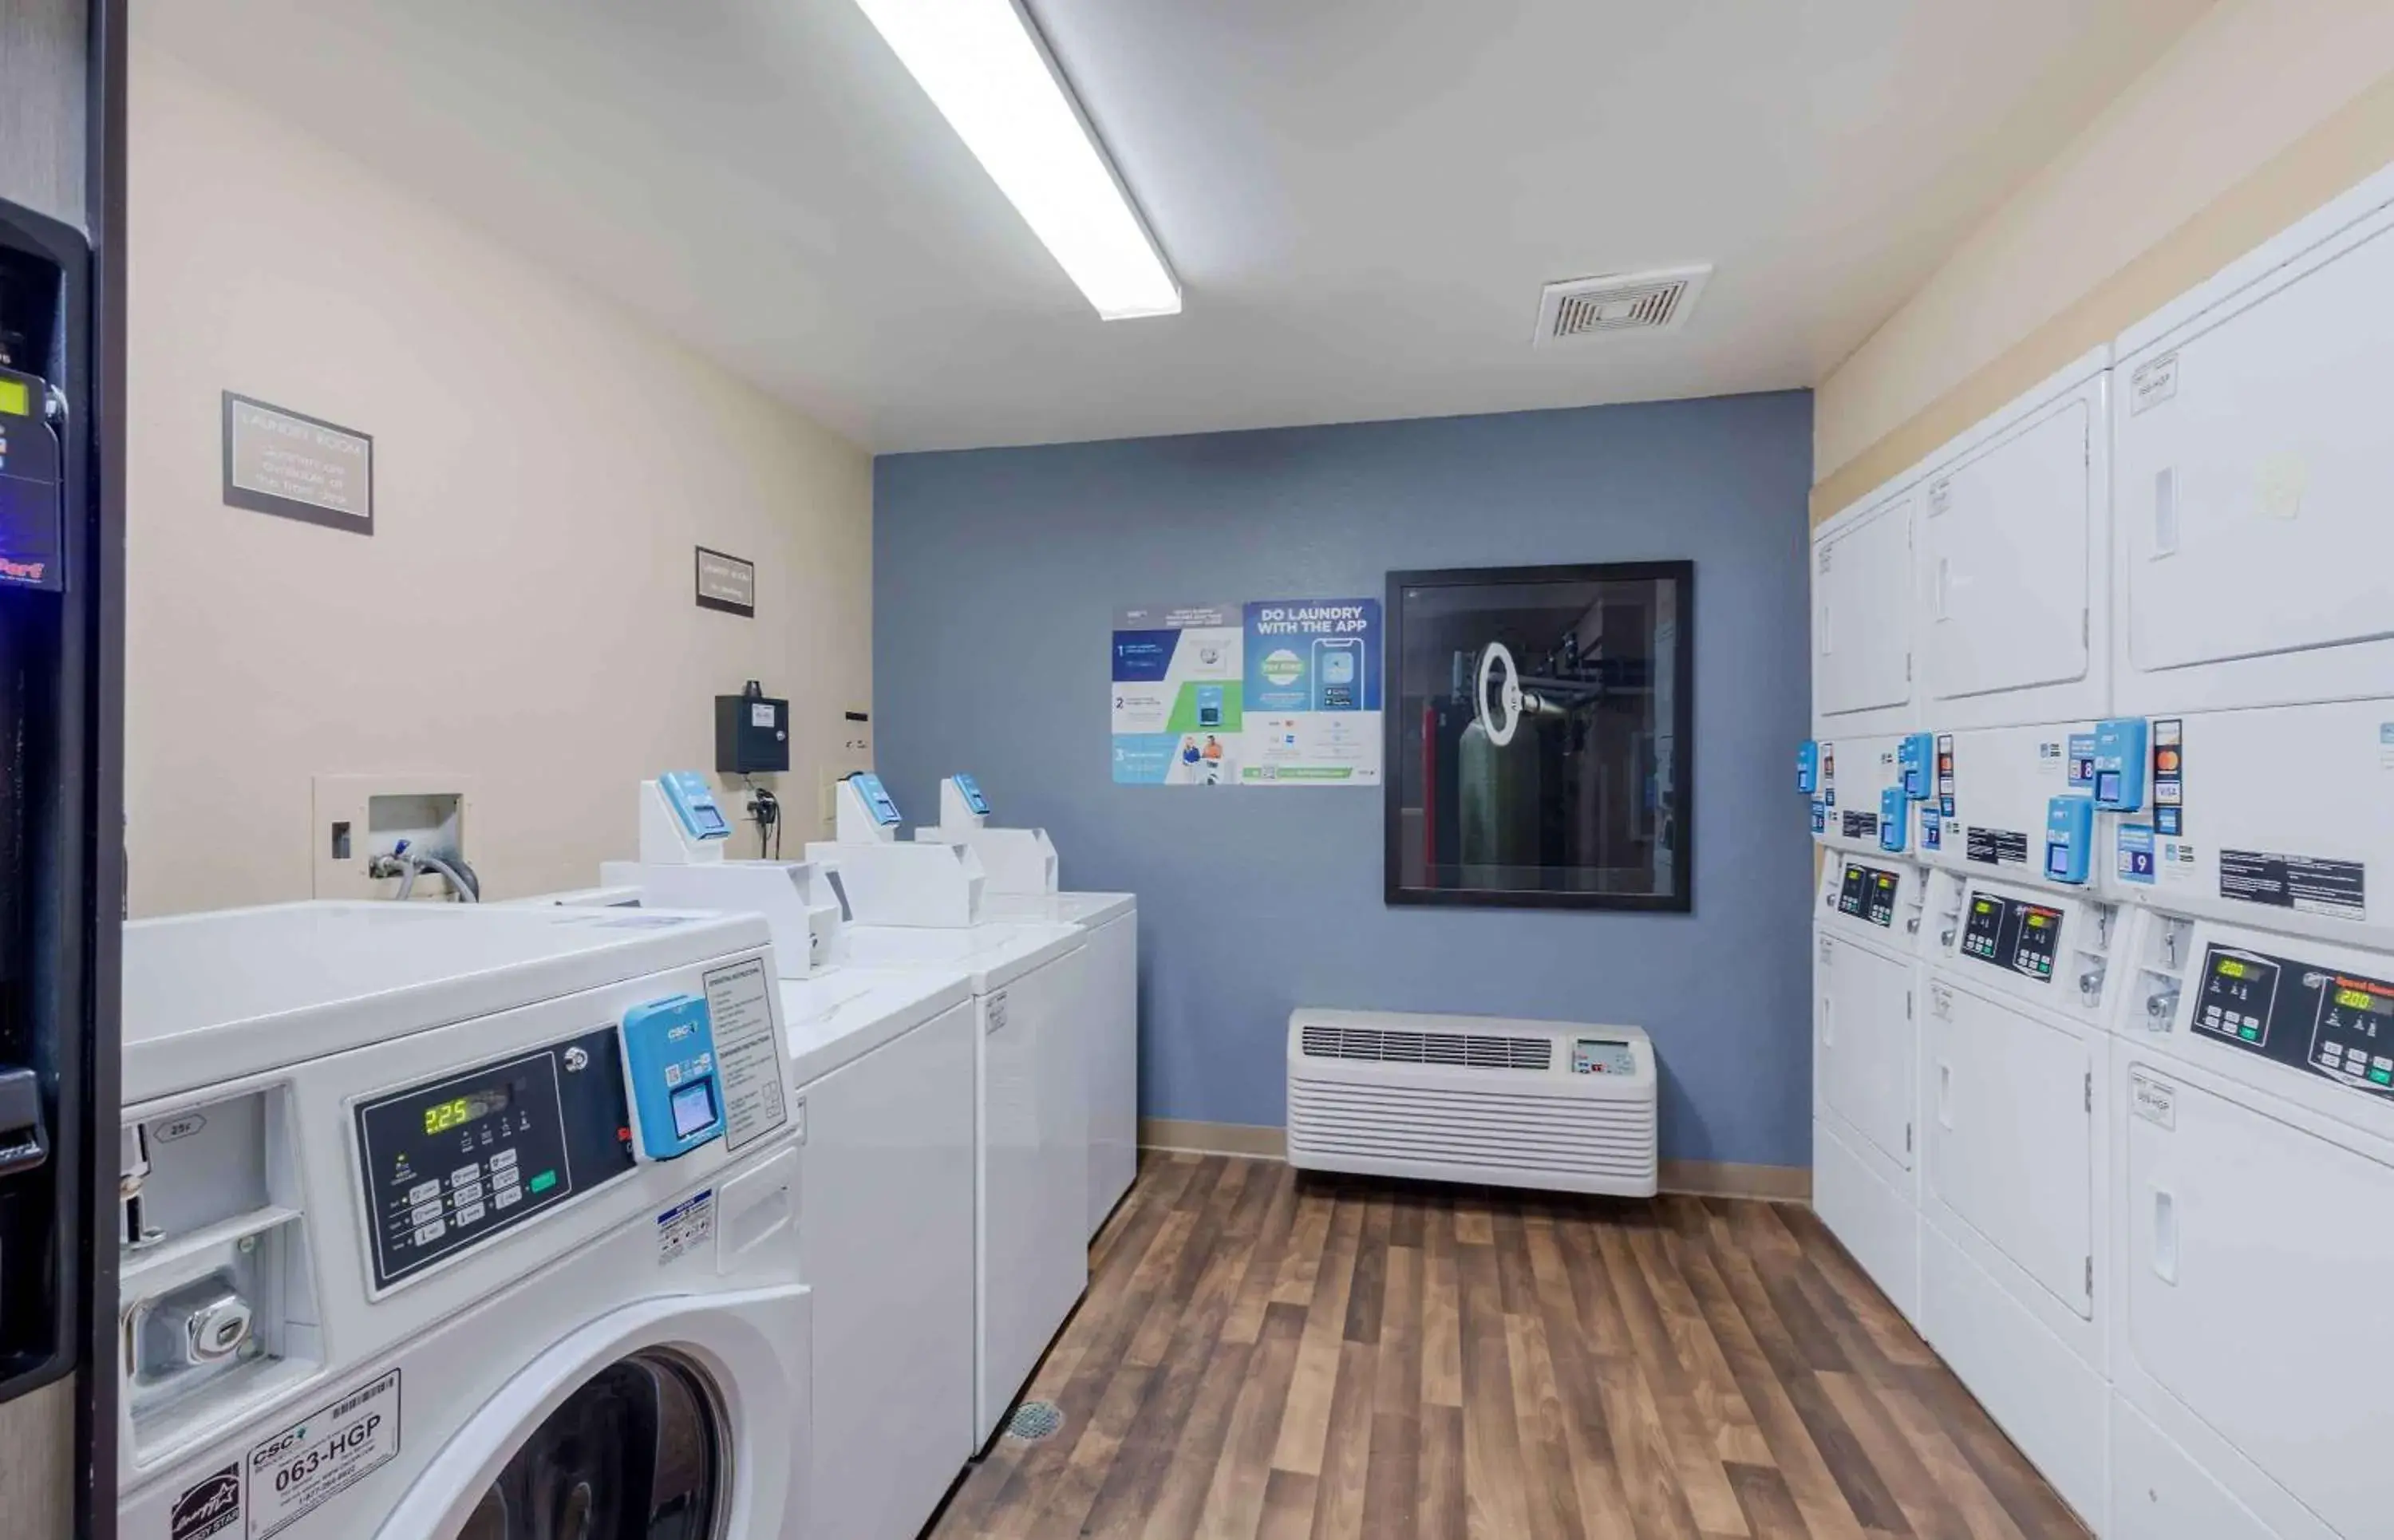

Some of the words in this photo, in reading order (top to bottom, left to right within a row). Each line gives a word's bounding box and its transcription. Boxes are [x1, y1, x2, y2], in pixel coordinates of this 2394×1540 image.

[1262, 609, 1285, 621] DO
[1288, 606, 1363, 620] LAUNDRY
[1258, 622, 1298, 635] WITH
[1302, 621, 1332, 633] THE
[1335, 620, 1367, 633] APP
[1118, 645, 1124, 657] 1
[1116, 697, 1124, 709] 2
[1116, 748, 1124, 760] 3
[2084, 762, 2093, 777] 8
[2138, 855, 2147, 871] 9
[253, 1435, 294, 1466] CSC
[275, 1414, 381, 1492] 063-HGP
